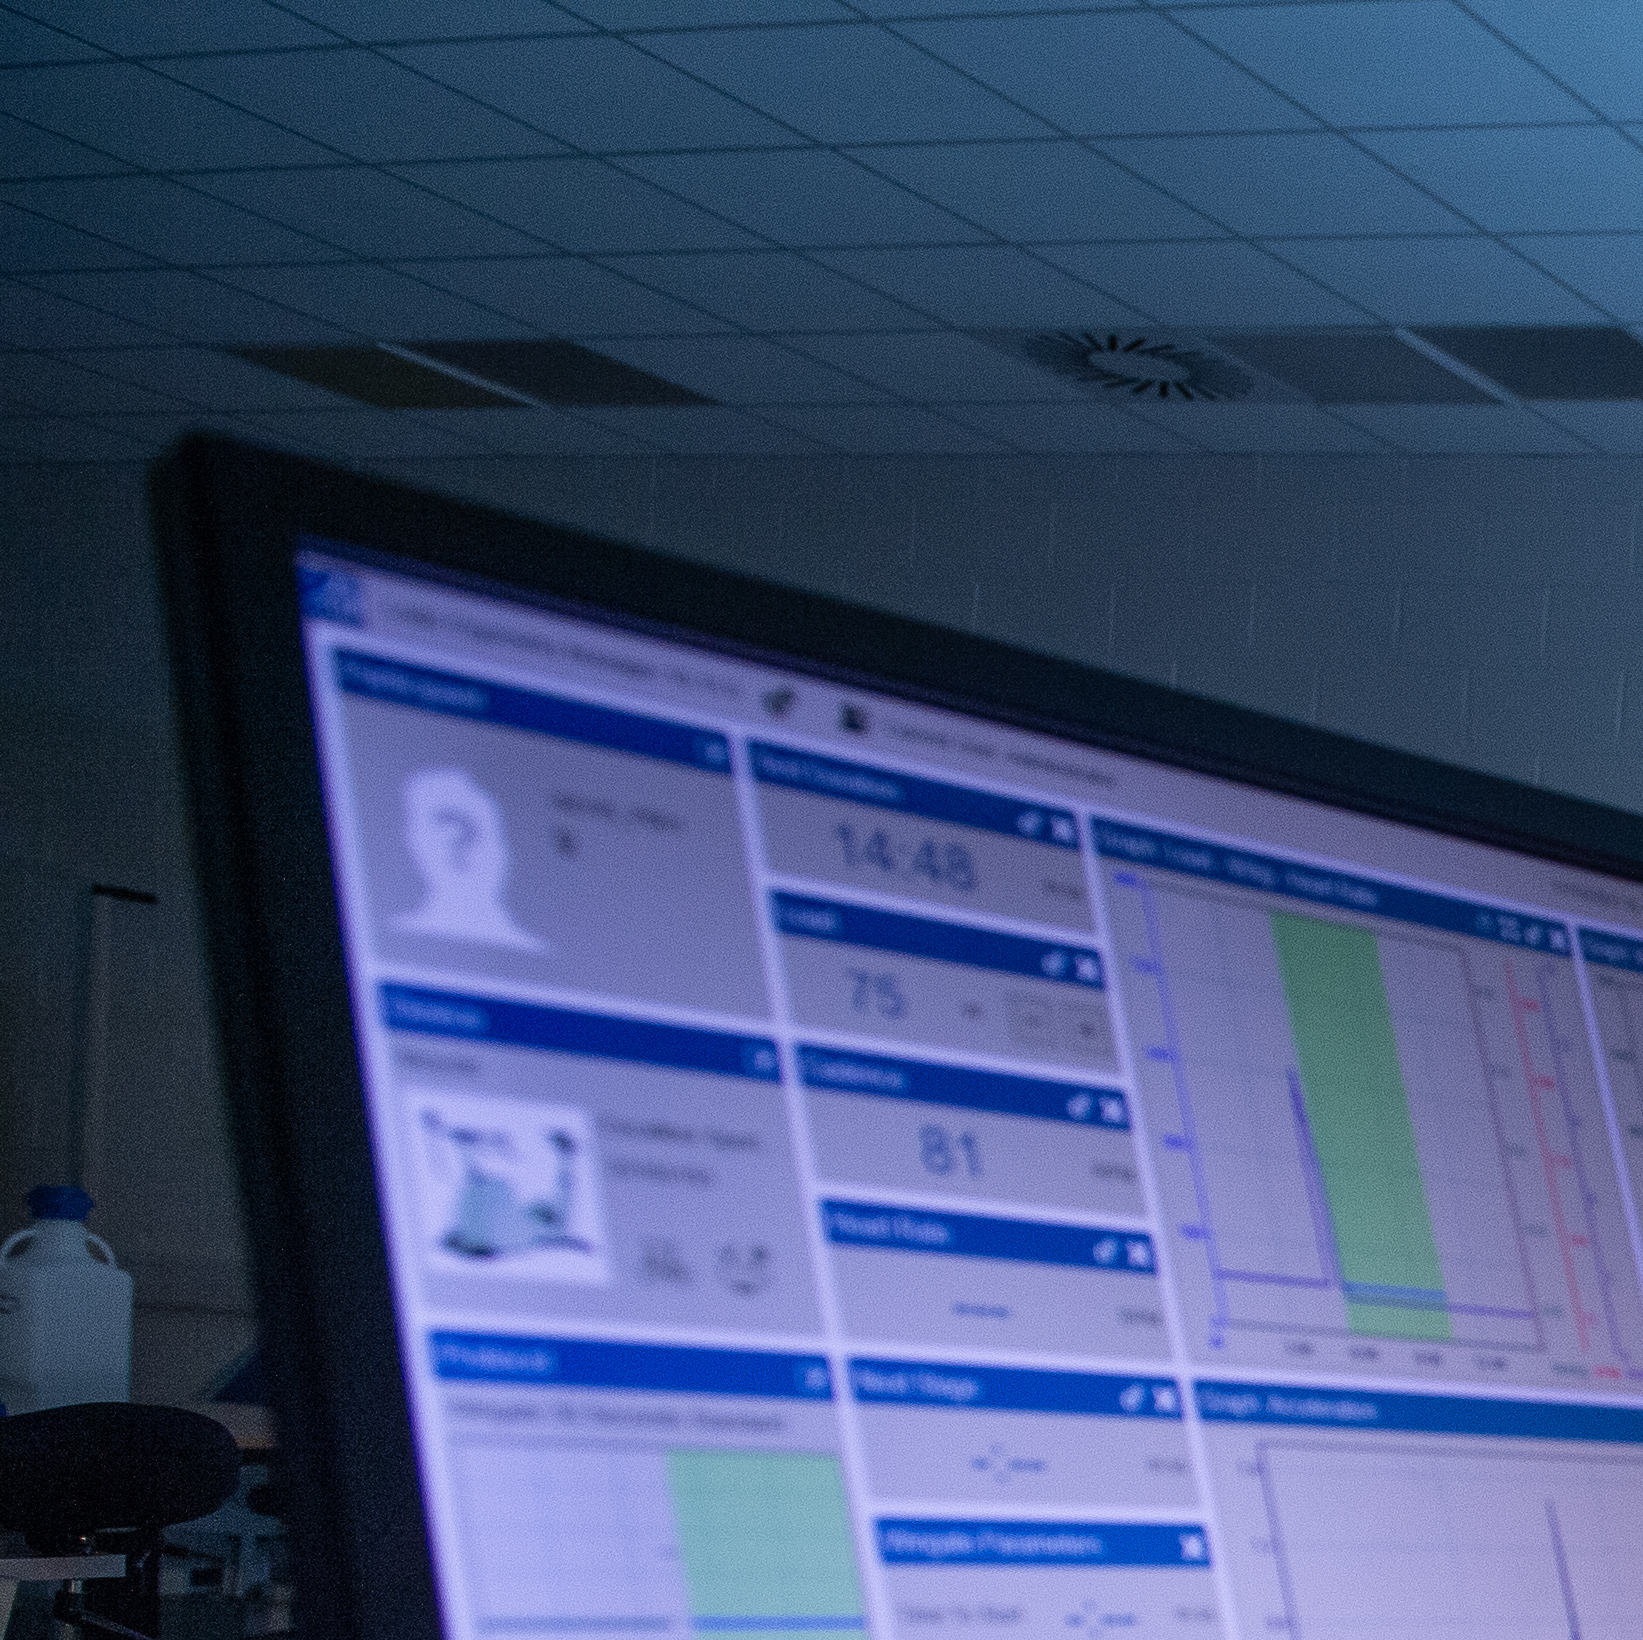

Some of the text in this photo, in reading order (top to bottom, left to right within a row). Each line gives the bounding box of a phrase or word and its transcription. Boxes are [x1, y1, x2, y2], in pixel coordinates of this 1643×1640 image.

[836, 822, 979, 894] 14:48
[847, 967, 907, 1022] 75
[917, 1122, 983, 1180] 81
